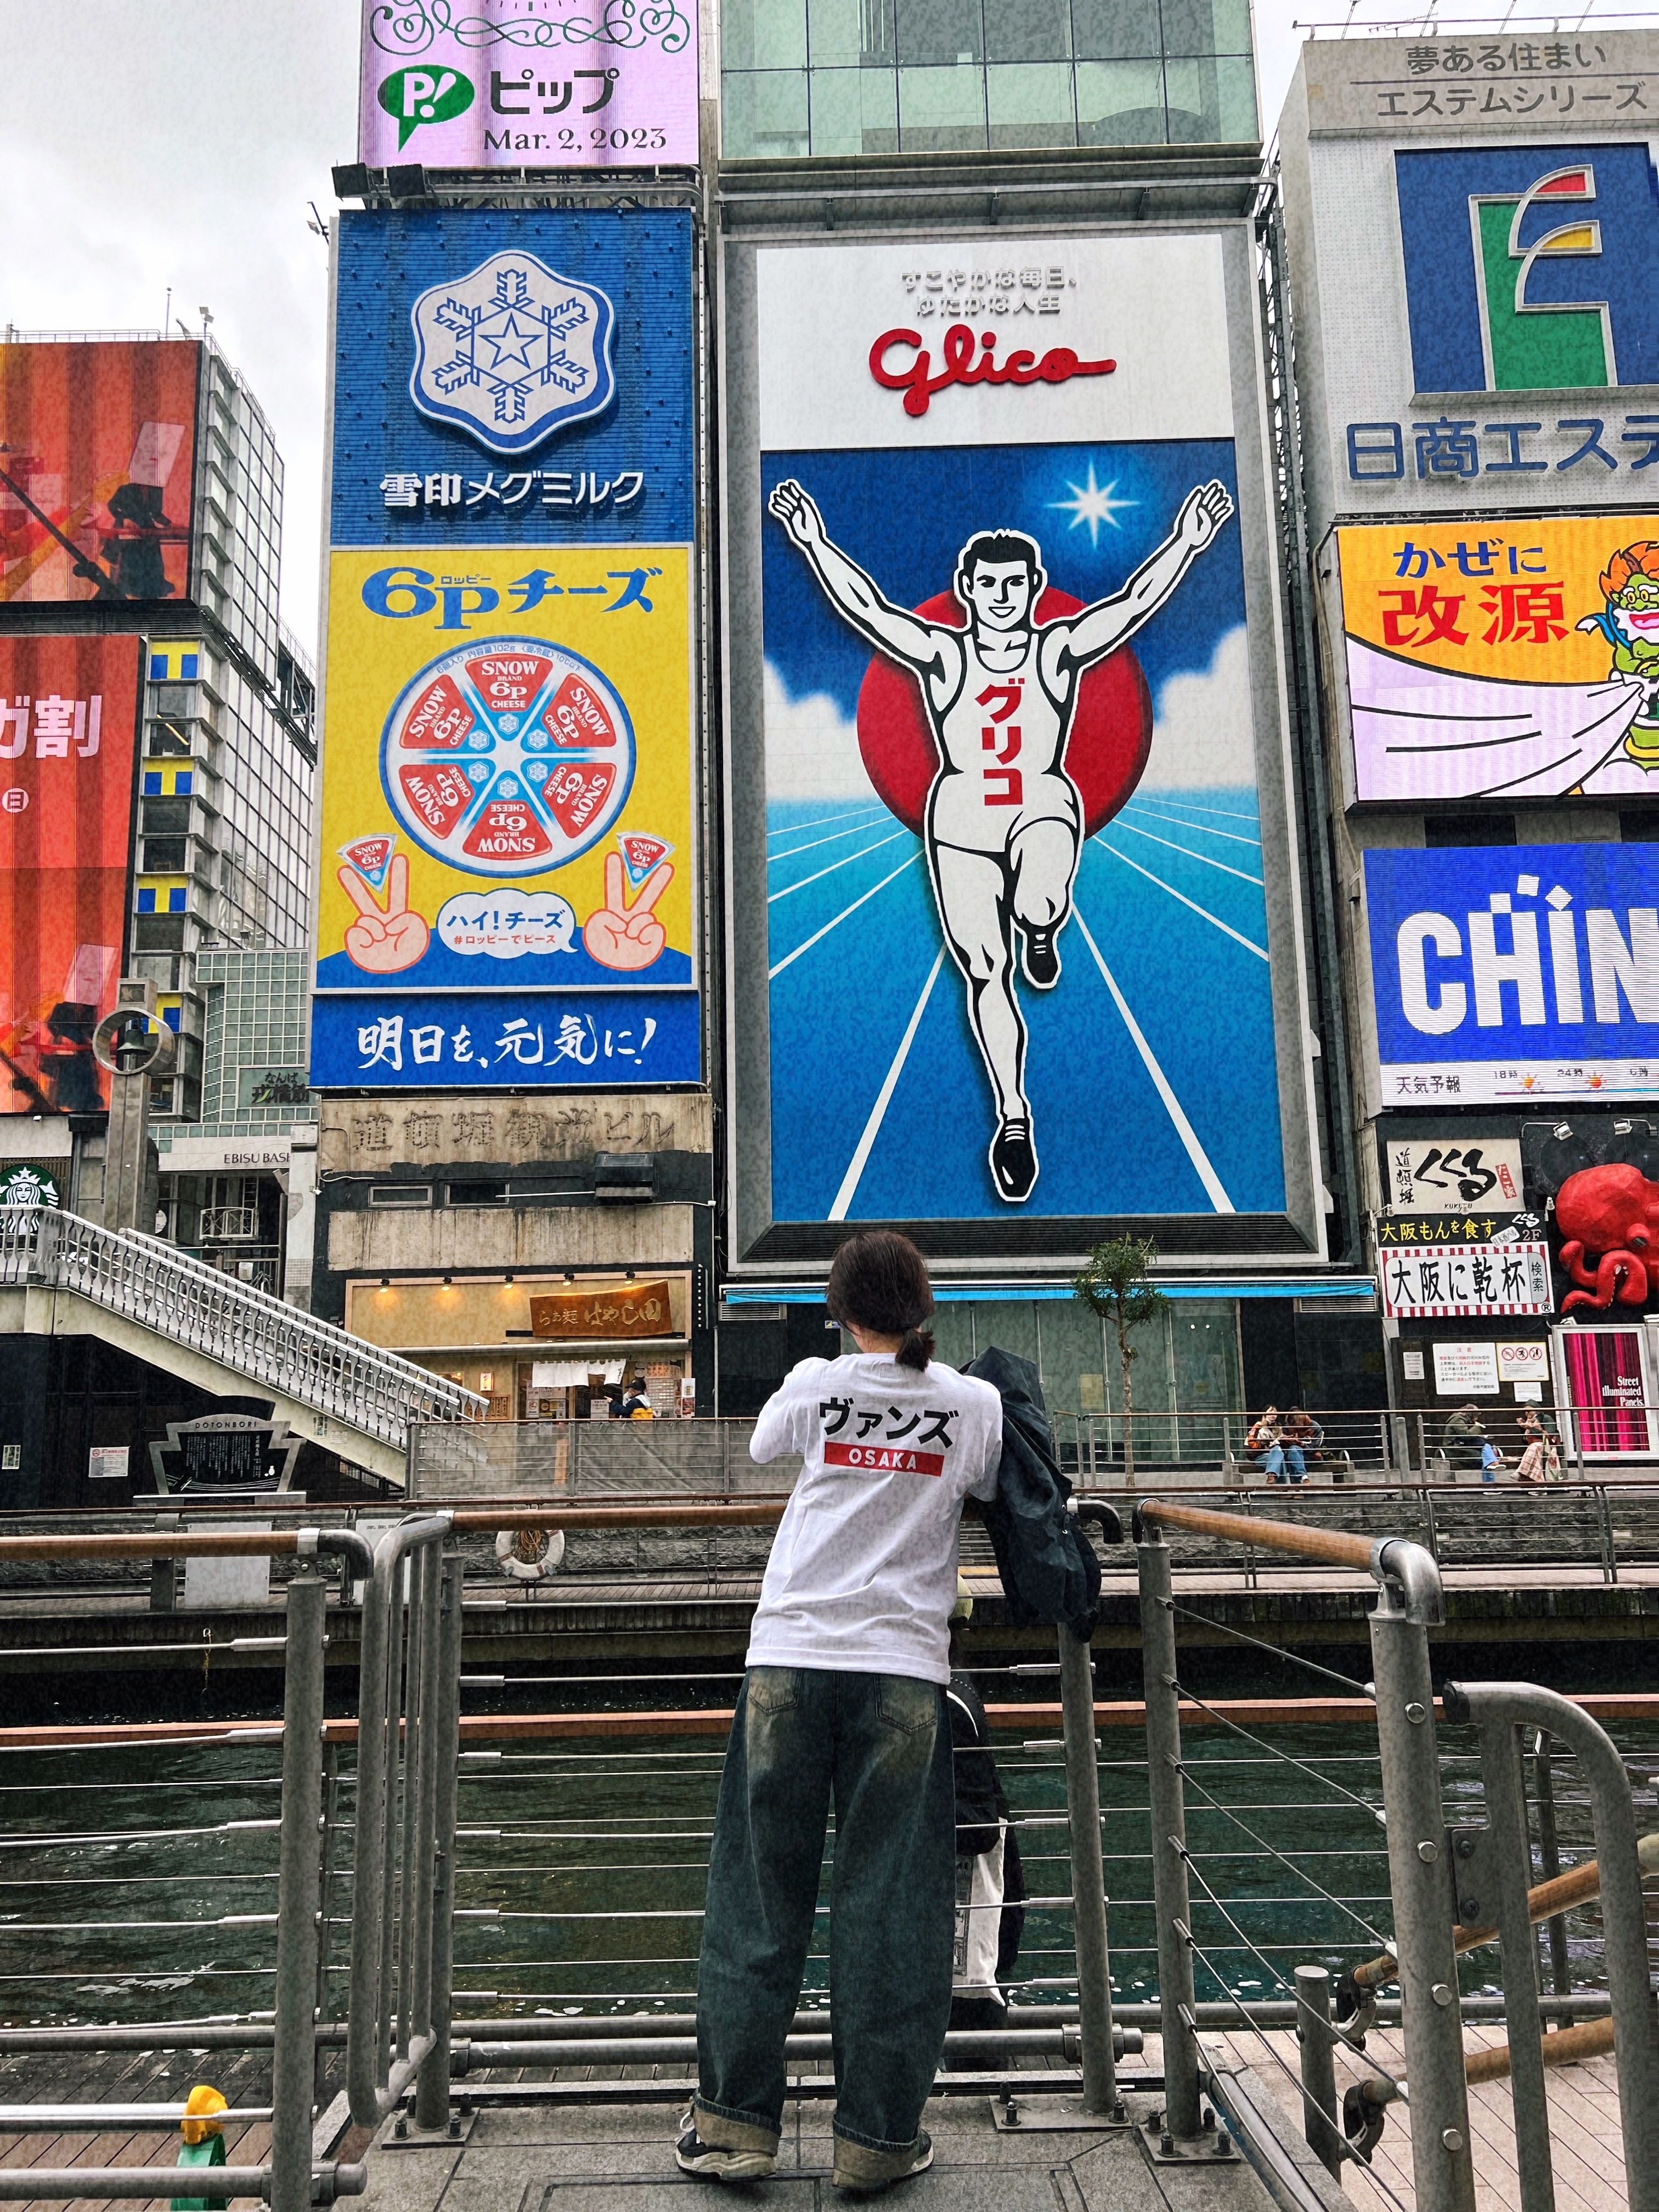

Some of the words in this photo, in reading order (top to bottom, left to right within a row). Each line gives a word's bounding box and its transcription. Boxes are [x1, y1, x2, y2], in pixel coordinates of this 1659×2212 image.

[1406, 42, 1606, 75] 夢ある住まい
[490, 67, 620, 114] ピップ
[1377, 81, 1647, 116] エステムシリーズ
[483, 129, 549, 150] Mar.
[558, 128, 583, 152] 2,
[590, 128, 667, 149] 2023
[902, 266, 1077, 291] すこやかな毎日、
[917, 292, 1060, 317] ゆたかな人生
[869, 324, 1117, 417] Glico
[379, 471, 644, 507] 雪印メグミルク
[1393, 538, 1547, 578] かぜに
[441, 574, 491, 584] ロッピー
[1378, 580, 1570, 647] 改源
[437, 655, 464, 674] 6個入り
[481, 661, 539, 675] SNOW
[409, 685, 448, 738] SNOW
[492, 700, 526, 708] CHEESE
[570, 687, 611, 736] SNOW
[430, 706, 446, 728] BRAND
[545, 714, 567, 744] CHEESE
[572, 706, 588, 729] BRAND
[450, 715, 472, 746] CHEESE
[975, 678, 1025, 806] グリコ
[449, 766, 471, 798] CHEESE
[544, 766, 567, 797] CHEESE
[405, 776, 445, 825] SNOW
[570, 774, 607, 828] SNOW
[354, 842, 382, 856] SNOW
[477, 837, 535, 853] SNOW
[631, 840, 659, 853] SNOW
[265, 1072, 299, 1084] なんば
[1396, 1076, 1461, 1094] 天気予報
[224, 1153, 260, 1164] EBISU
[1396, 1147, 1414, 1204] 道頓堀
[1414, 1149, 1497, 1201] くくる
[1381, 1218, 1497, 1242] 大阪もんを食す
[1512, 1213, 1539, 1228] くくる
[1522, 1229, 1542, 1241] 2F
[1392, 1256, 1526, 1304] 大阪に乾杯
[1531, 1262, 1543, 1292] 検索
[1602, 1385, 1641, 1396] Illuminated
[1617, 1376, 1639, 1386] Street
[1620, 1397, 1645, 1407] Panels.
[820, 1397, 959, 1449] ヴァンズ
[849, 1448, 917, 1470] OSAKA
